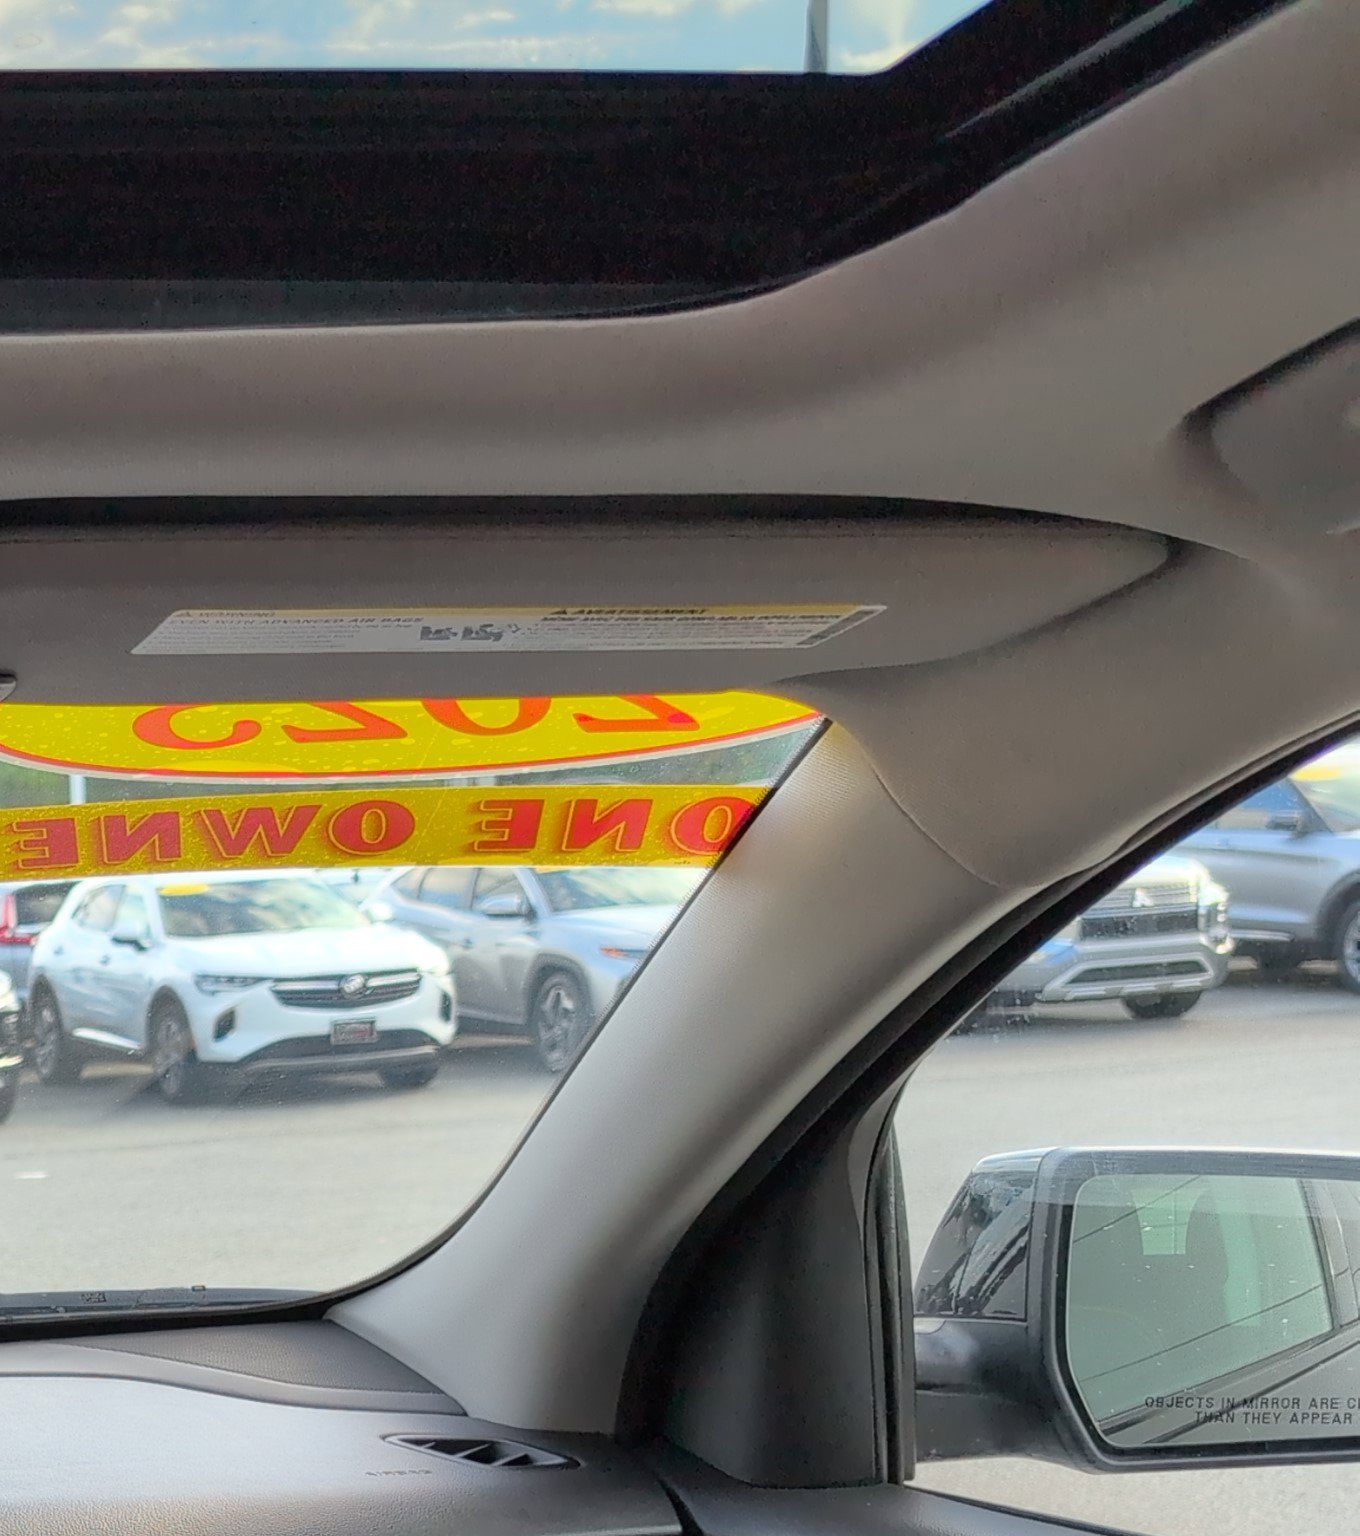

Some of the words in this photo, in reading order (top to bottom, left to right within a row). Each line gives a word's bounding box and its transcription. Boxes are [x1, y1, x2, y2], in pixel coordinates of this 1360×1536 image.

[1144, 1395, 1215, 1410] OBJECTS
[1220, 1396, 1236, 1409] IN
[1242, 1396, 1299, 1410] MIRROR
[1308, 1397, 1340, 1410] ARE
[1195, 1411, 1235, 1424] THAN
[1243, 1411, 1282, 1424] THEY
[1289, 1411, 1353, 1425] APPEAR
